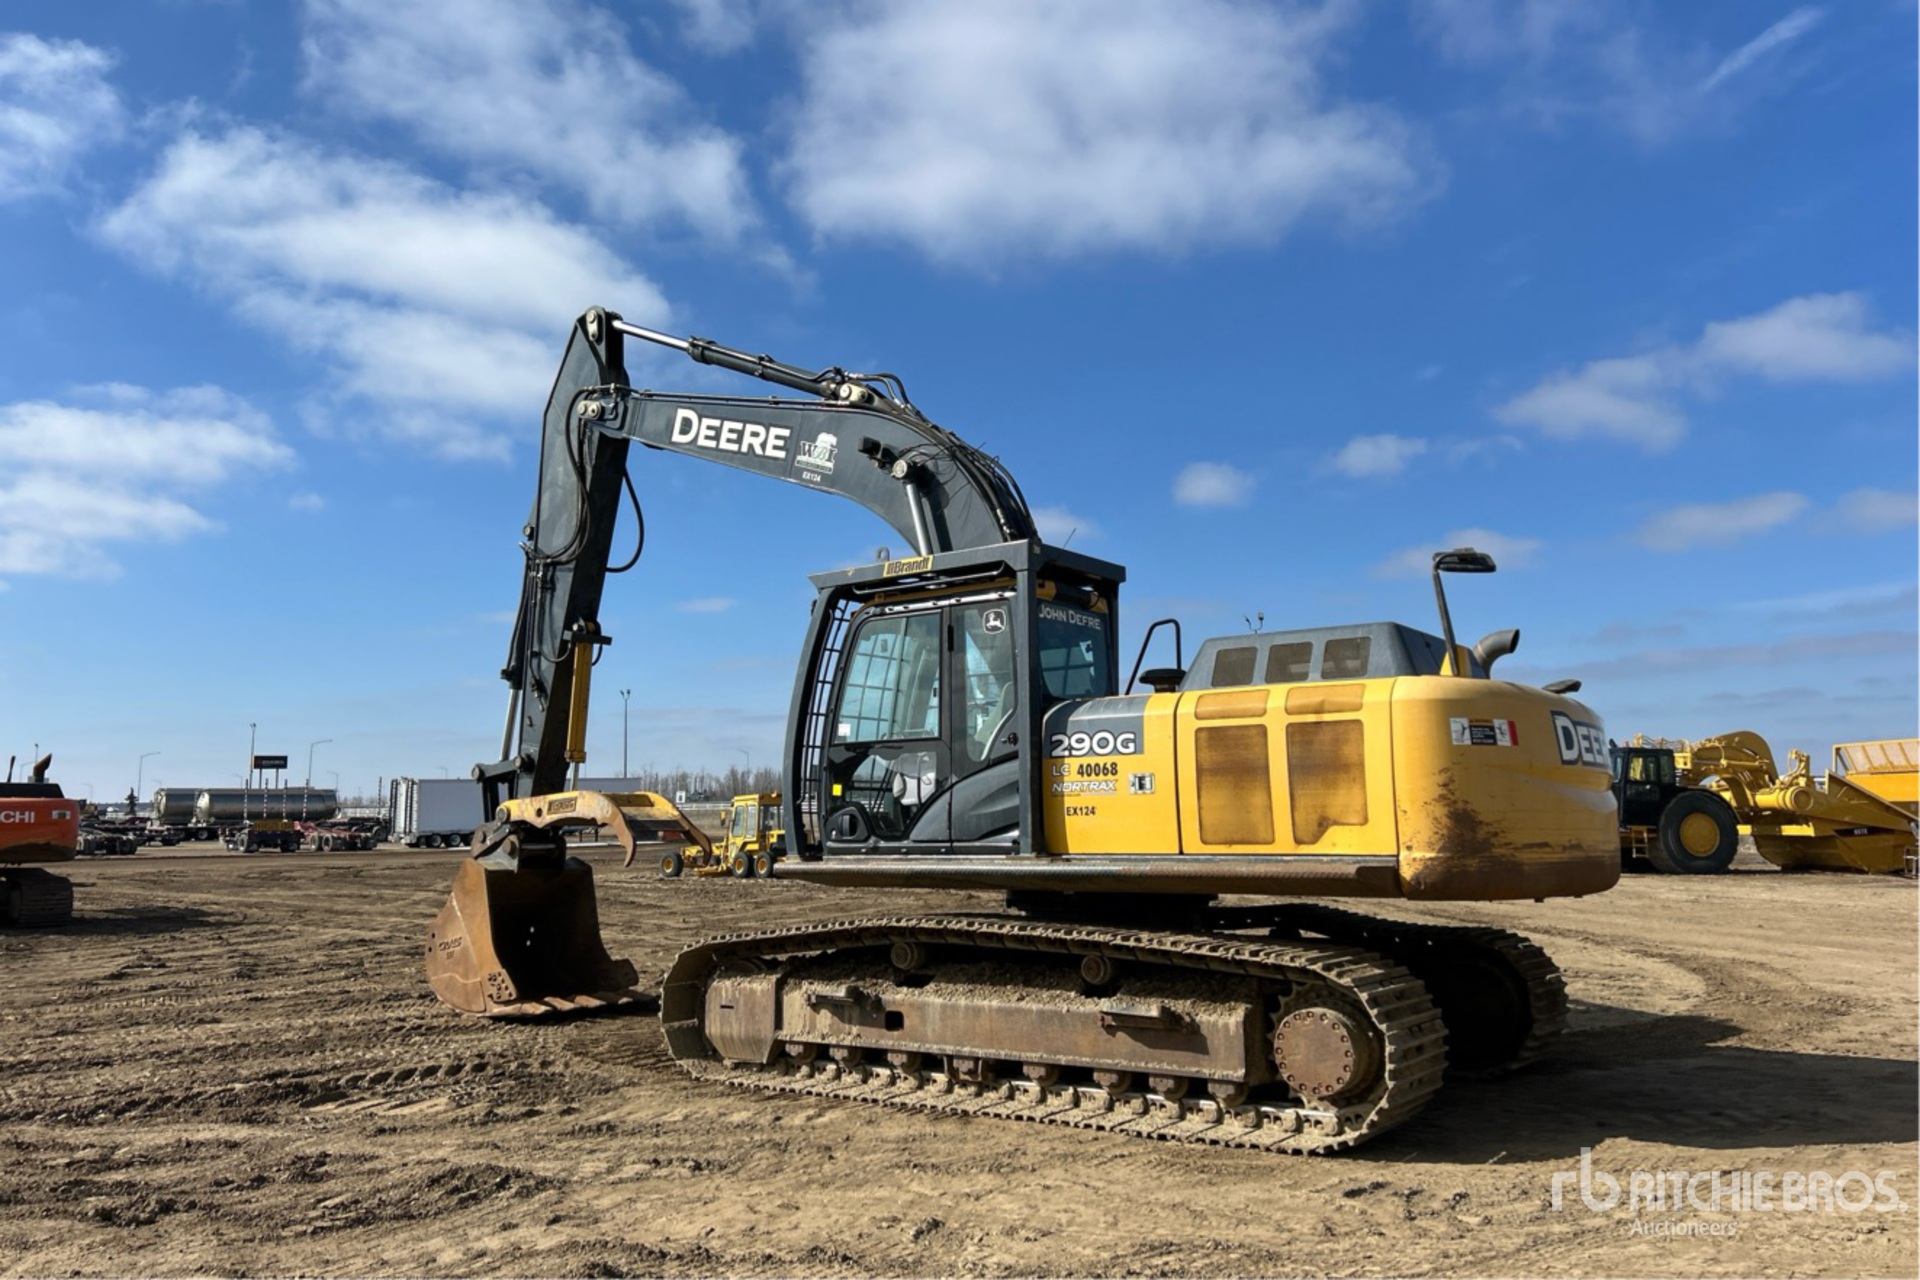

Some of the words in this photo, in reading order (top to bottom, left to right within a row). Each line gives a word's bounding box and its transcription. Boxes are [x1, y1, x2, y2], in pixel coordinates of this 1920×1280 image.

[672, 409, 790, 458] DEERE
[1039, 604, 1067, 623] JOHN
[1051, 730, 1136, 757] 290G
[1077, 762, 1118, 778] 40068
[1052, 779, 1117, 793] NORTRAX
[1066, 806, 1096, 817] EX124
